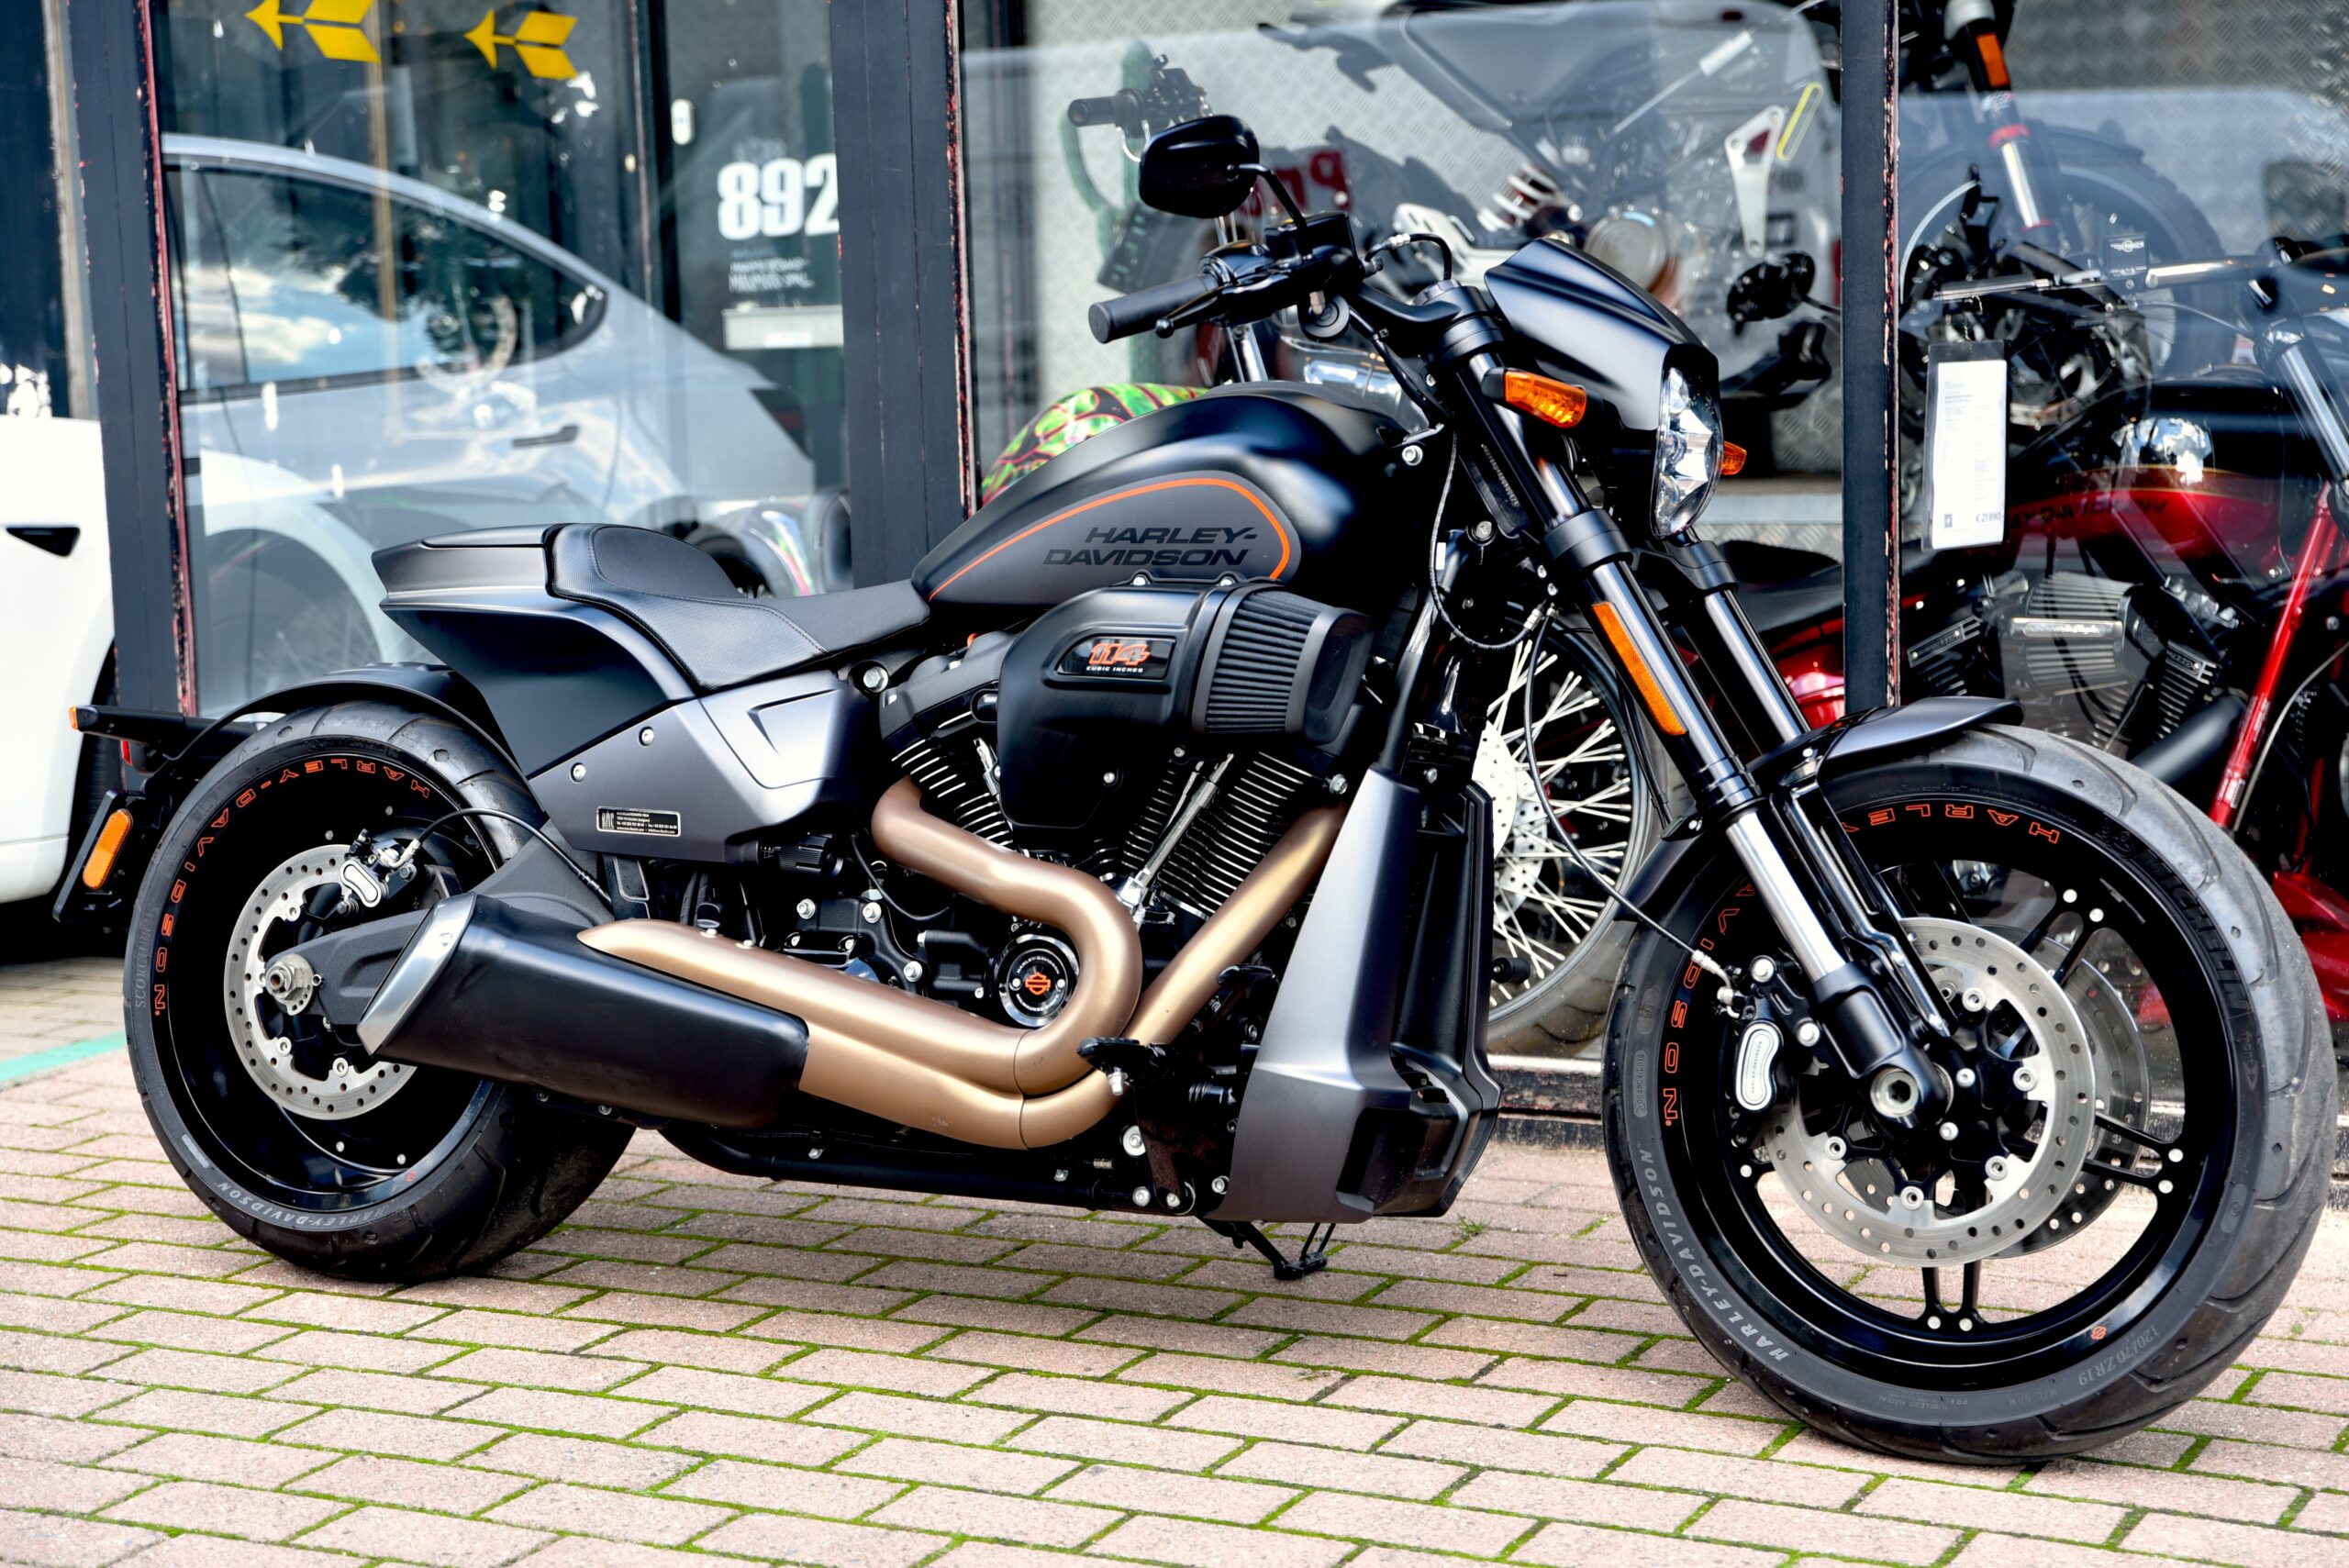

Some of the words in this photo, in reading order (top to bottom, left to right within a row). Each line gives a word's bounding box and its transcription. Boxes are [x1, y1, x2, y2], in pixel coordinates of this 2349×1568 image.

[1085, 527, 1257, 544] HARLEY-
[1042, 549, 1250, 566] DAVIDSON
[1088, 642, 1151, 666] 114
[1017, 956, 1060, 974] HARLEY-DAVIDSON
[2077, 1360, 2116, 1386] ZR19
[1878, 1395, 1907, 1407] RADIAL
[1909, 1400, 1949, 1410] TUBELESS
